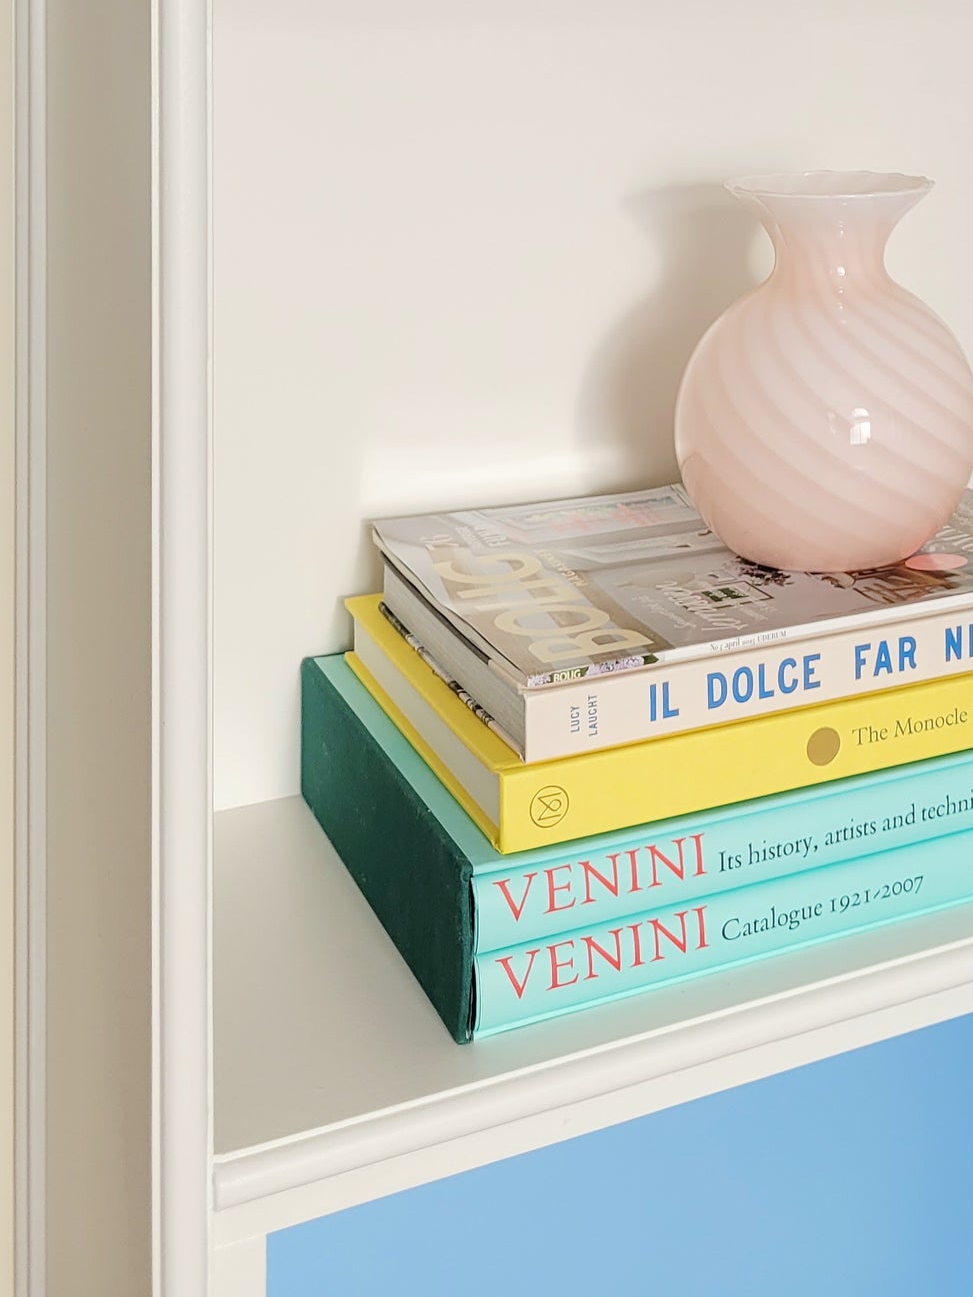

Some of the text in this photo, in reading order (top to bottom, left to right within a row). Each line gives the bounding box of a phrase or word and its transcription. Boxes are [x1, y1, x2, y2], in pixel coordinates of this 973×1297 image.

[725, 636, 740, 650] april
[650, 681, 680, 721] IL
[707, 653, 822, 710] DOLCE
[855, 636, 917, 680] FAR
[570, 705, 580, 734] LUCY
[588, 694, 599, 737] LAUCHT
[852, 724, 888, 746] The
[894, 707, 968, 738] Monocle
[493, 832, 708, 922] VENINI
[718, 850, 742, 873] Its
[749, 834, 819, 865] history,
[824, 818, 877, 846] artists
[882, 803, 916, 831] and
[495, 905, 711, 1000] VENINI
[721, 902, 823, 942] Catalogue
